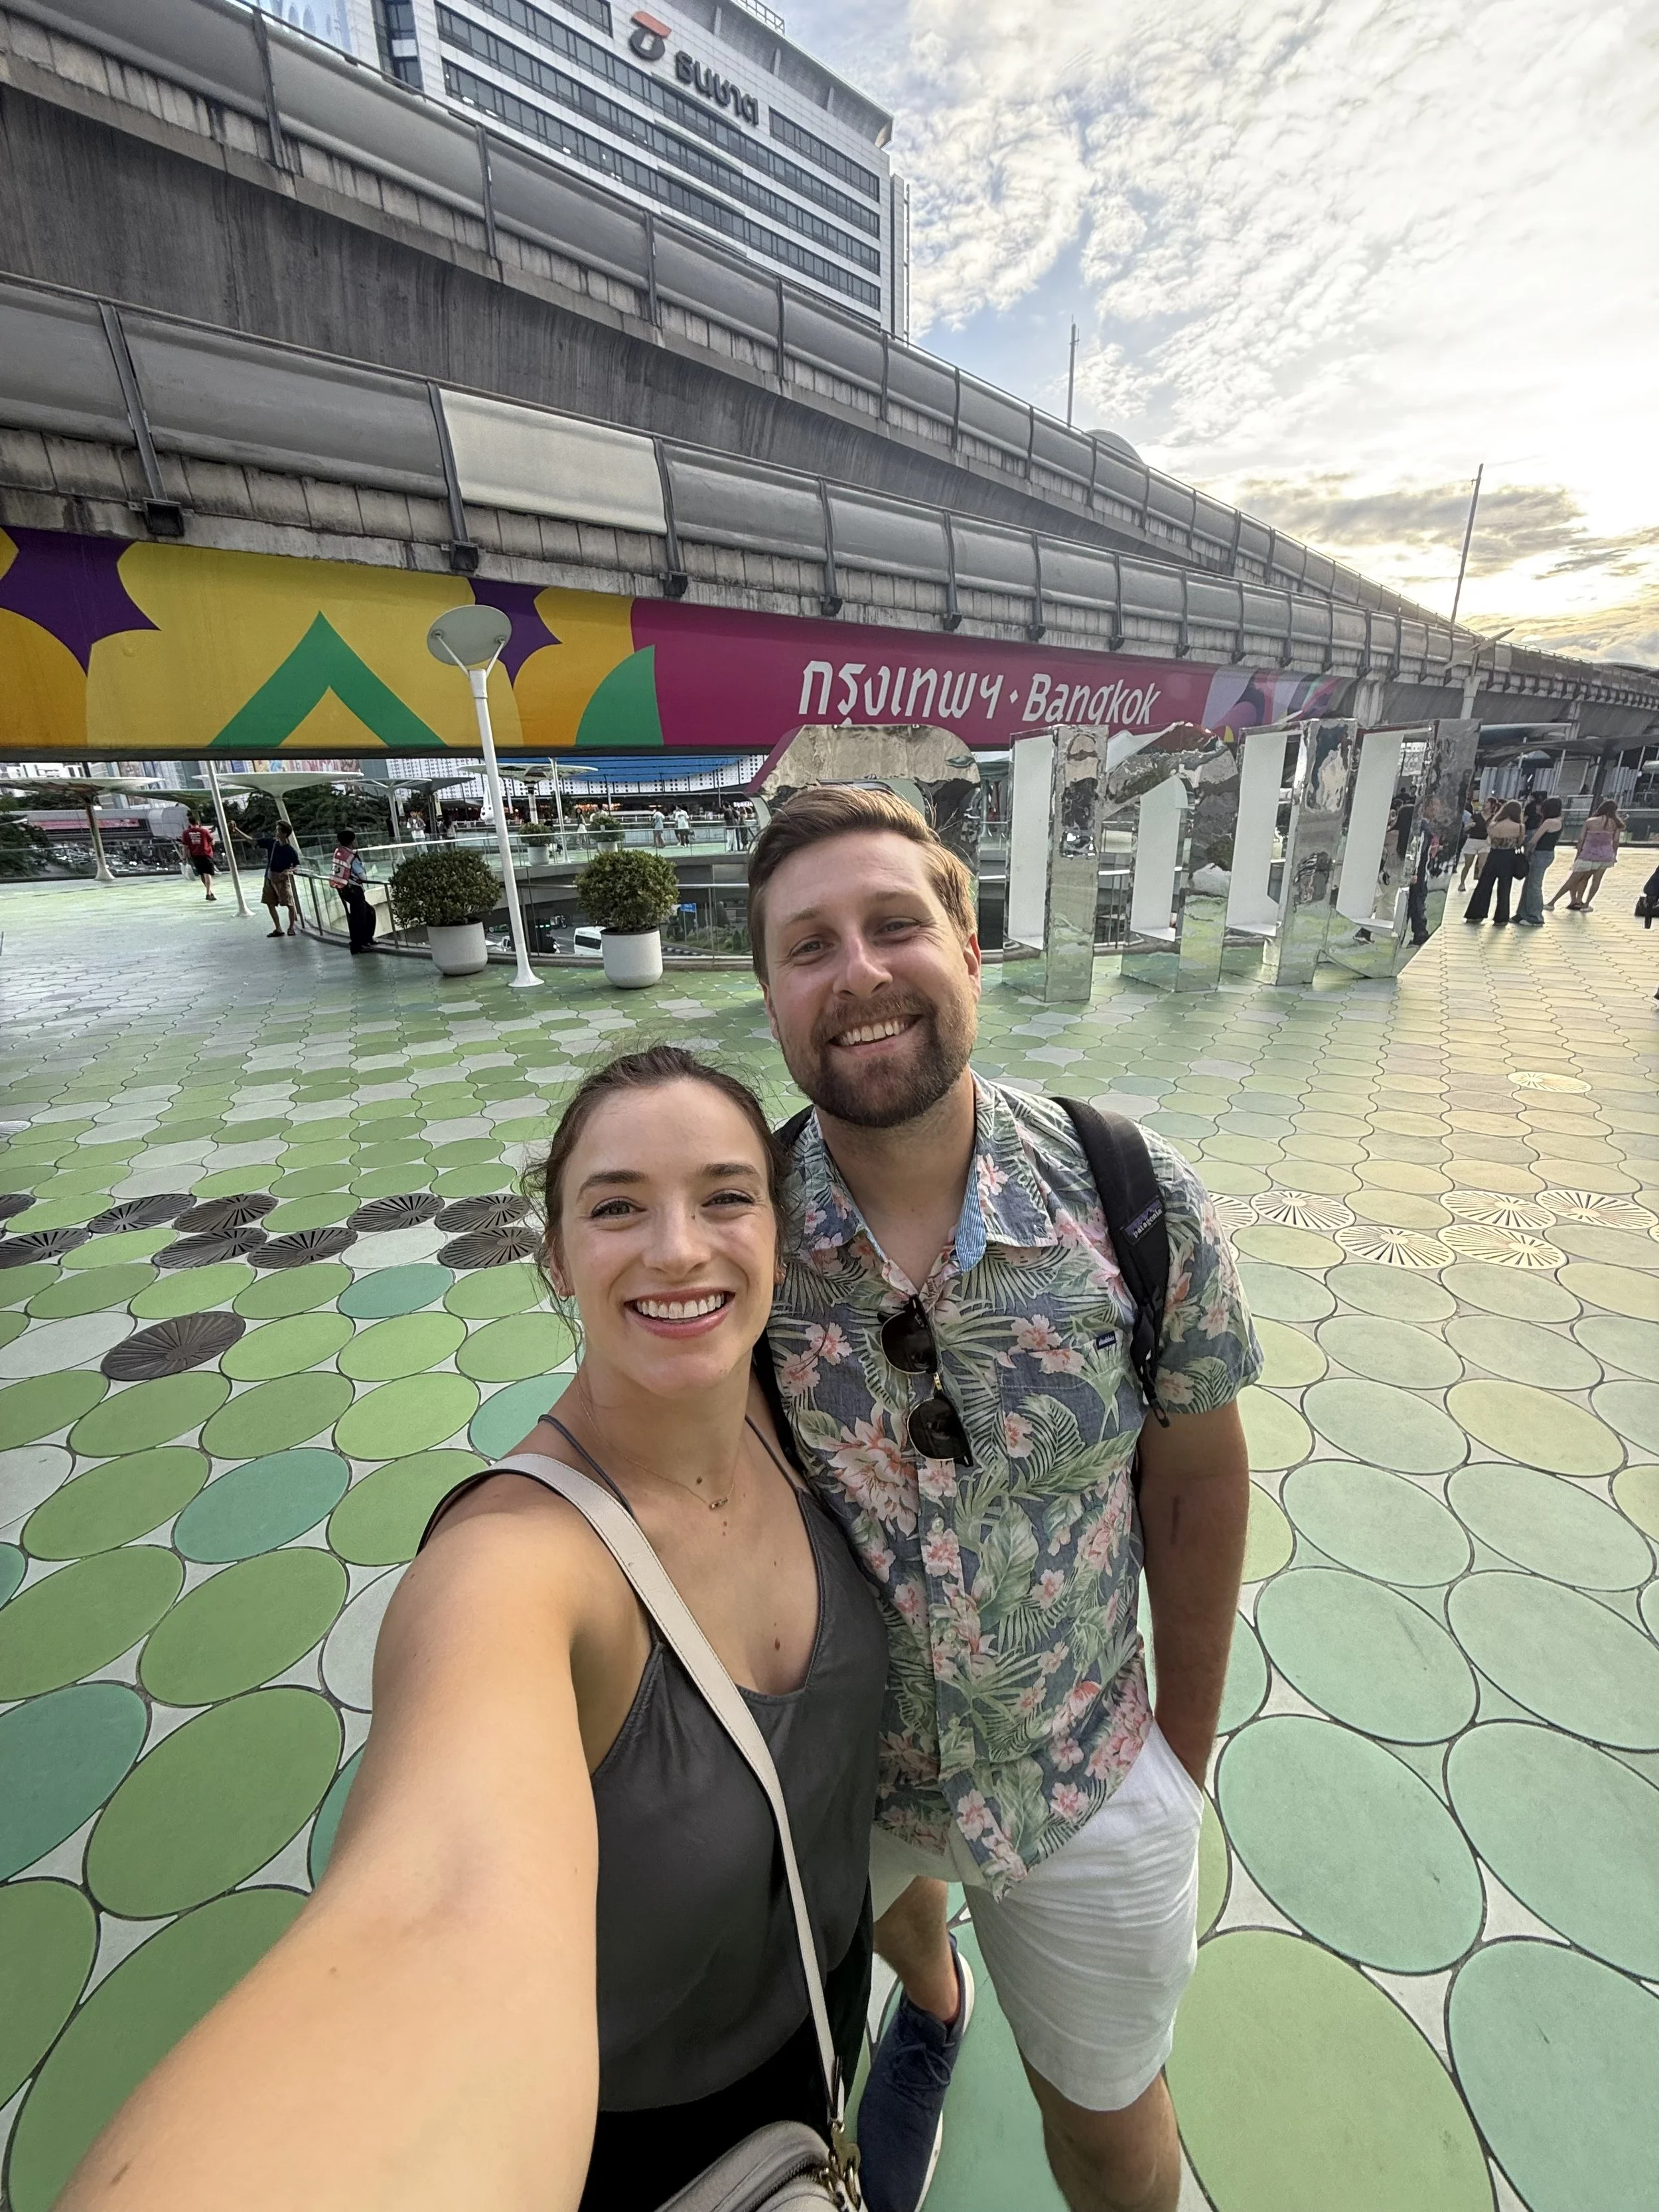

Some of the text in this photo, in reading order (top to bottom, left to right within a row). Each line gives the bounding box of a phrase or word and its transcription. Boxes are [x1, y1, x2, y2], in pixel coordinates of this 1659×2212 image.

[676, 50, 759, 126] ธนชาต
[1022, 673, 1162, 725] Bangkok
[1133, 1209, 1163, 1239] patagonia
